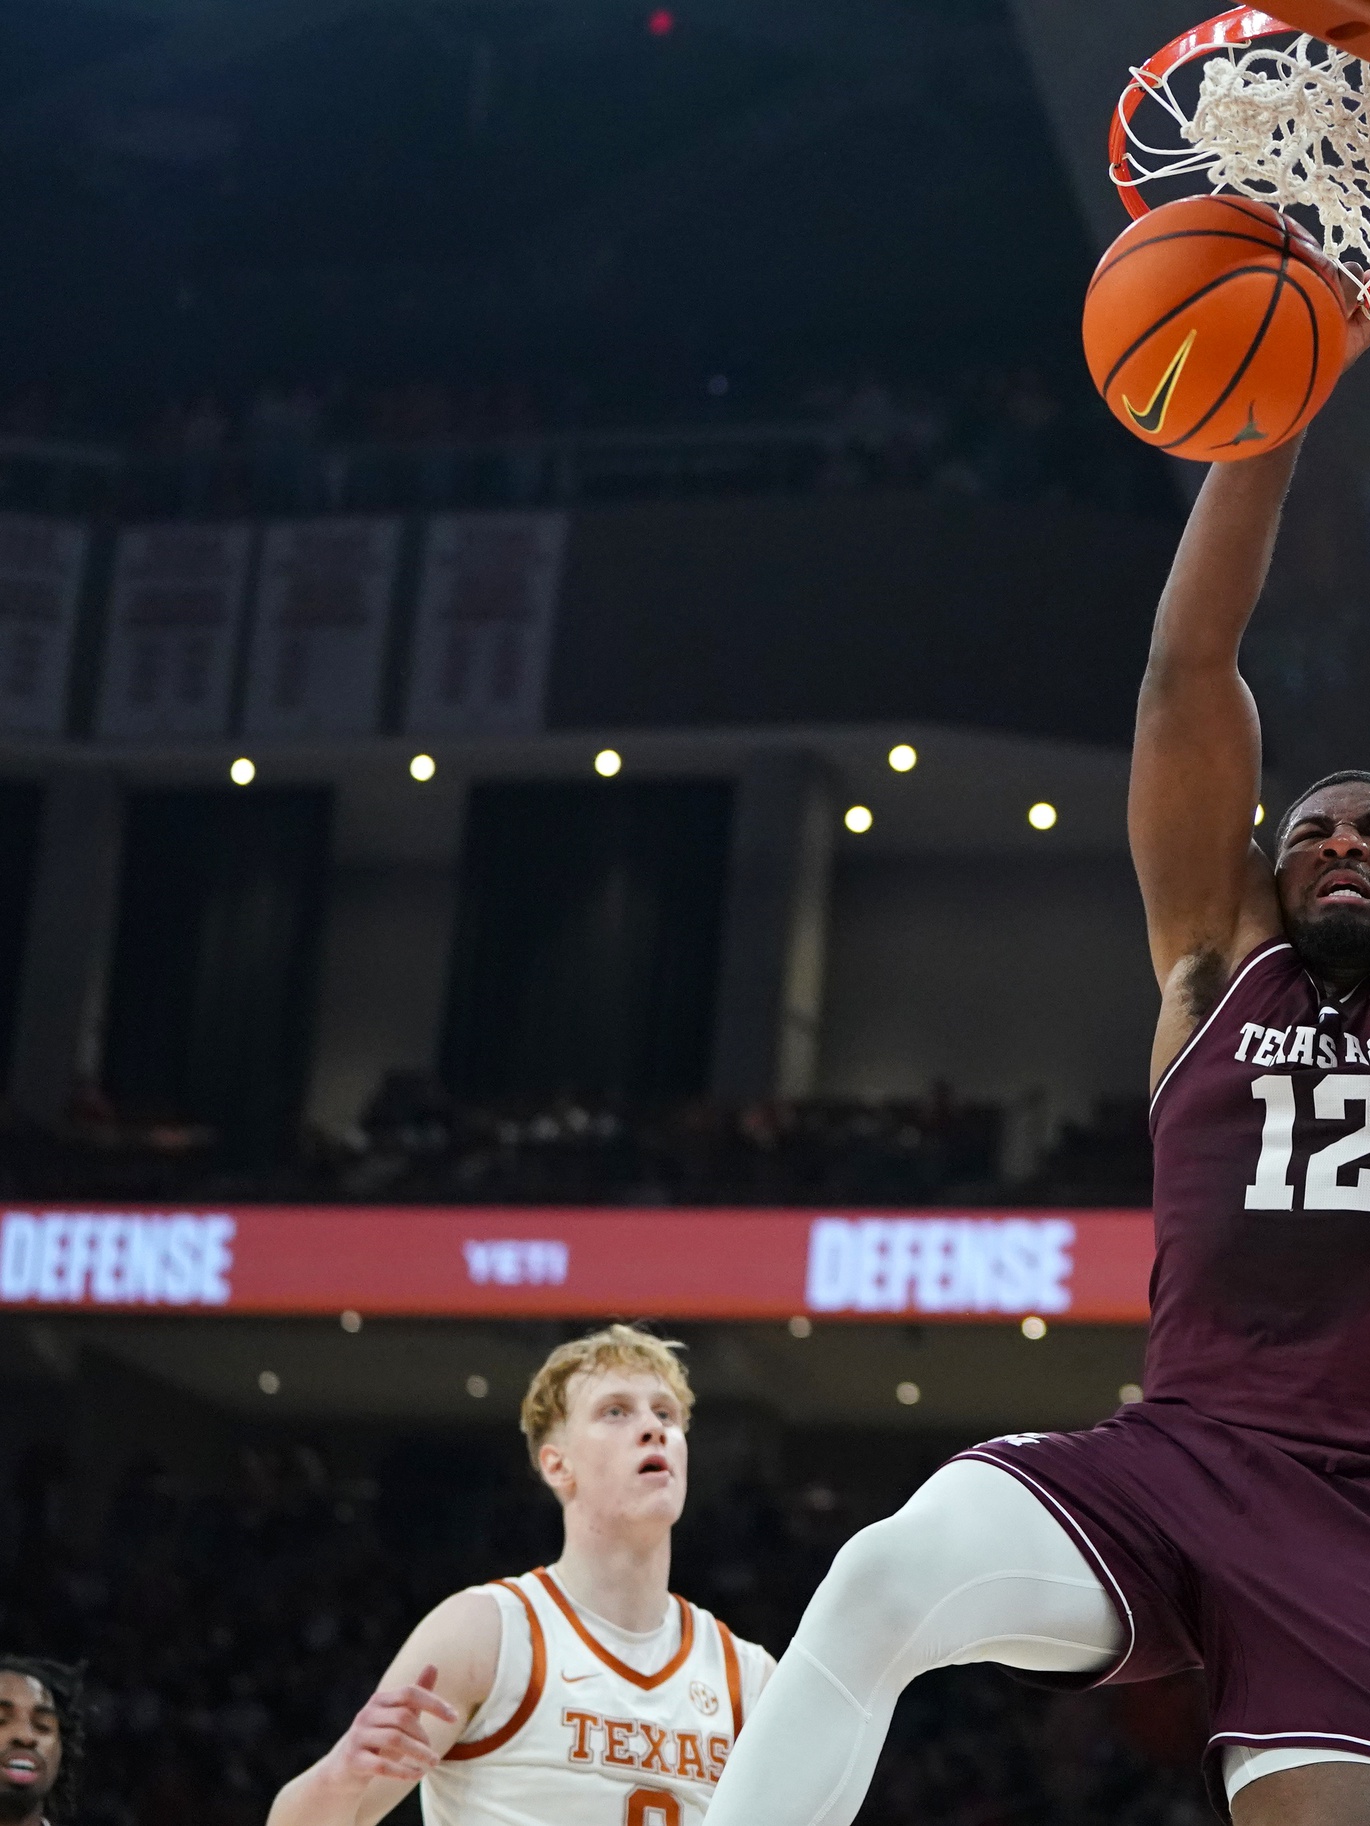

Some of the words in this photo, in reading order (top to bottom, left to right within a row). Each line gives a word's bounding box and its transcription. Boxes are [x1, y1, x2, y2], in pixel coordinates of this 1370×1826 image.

[1234, 1022, 1338, 1069] TEXAS
[1, 1211, 237, 1306] DEFENSE
[463, 1239, 568, 1286] YETI
[805, 1217, 1075, 1313] DEFENSE
[562, 1707, 735, 1786] TEXAS
